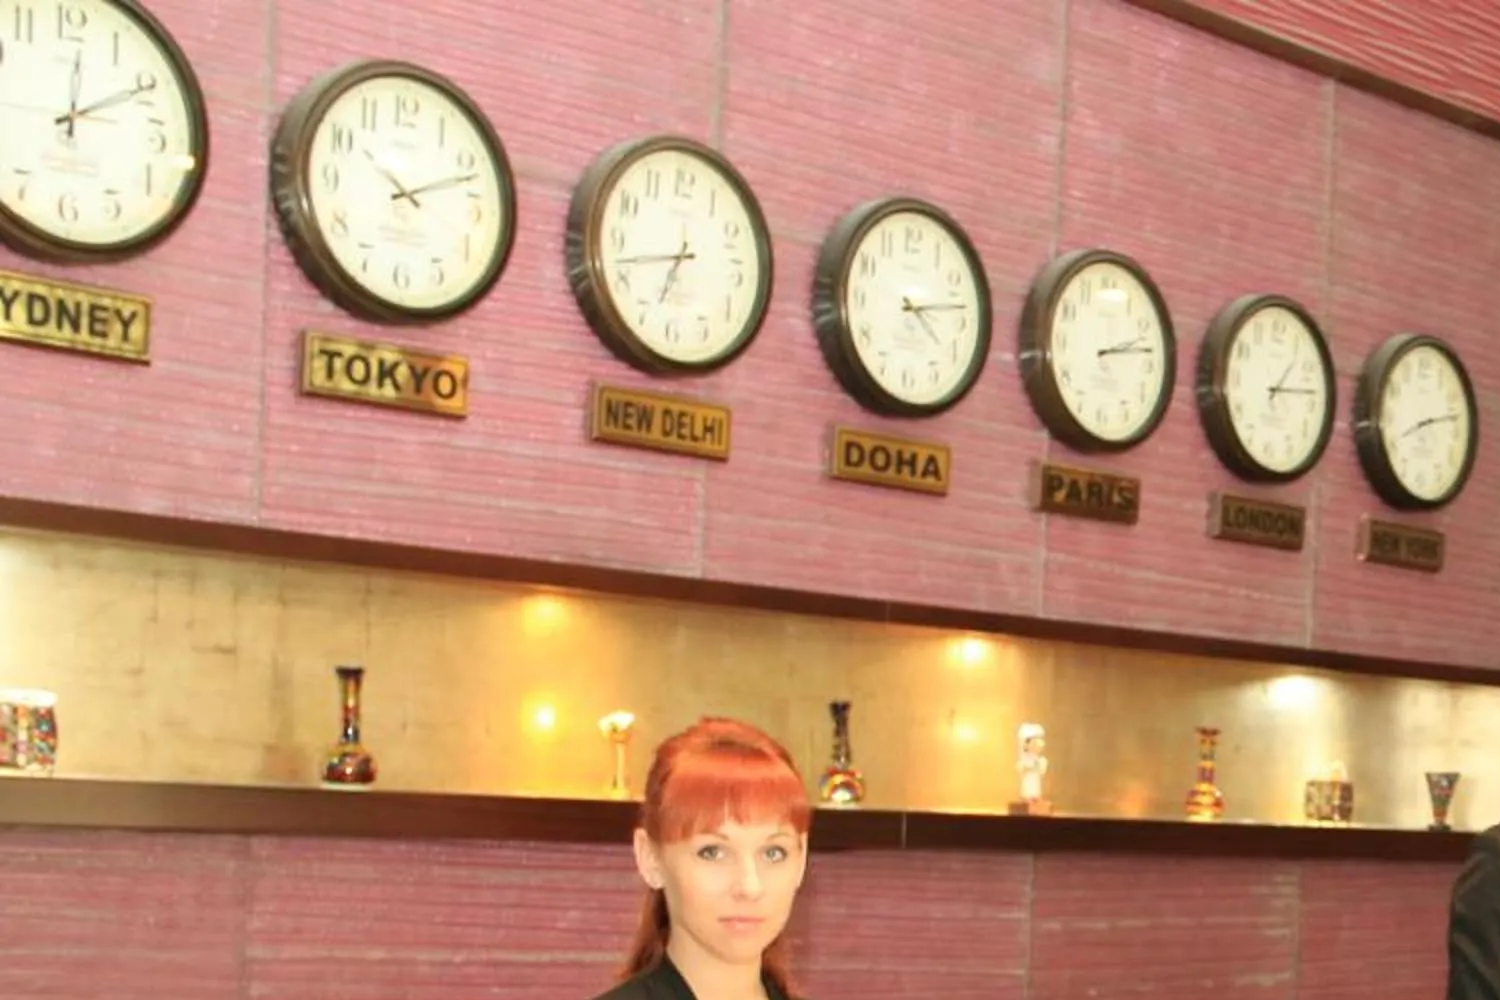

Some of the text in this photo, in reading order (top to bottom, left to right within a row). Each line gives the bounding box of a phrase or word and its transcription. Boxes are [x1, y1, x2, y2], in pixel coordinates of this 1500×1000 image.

[57, 3, 88, 43] 12
[319, 347, 457, 400] TOKYO
[604, 397, 724, 447] NEW DELHI
[845, 440, 942, 482] DOHA
[1047, 473, 1136, 511] PARIS
